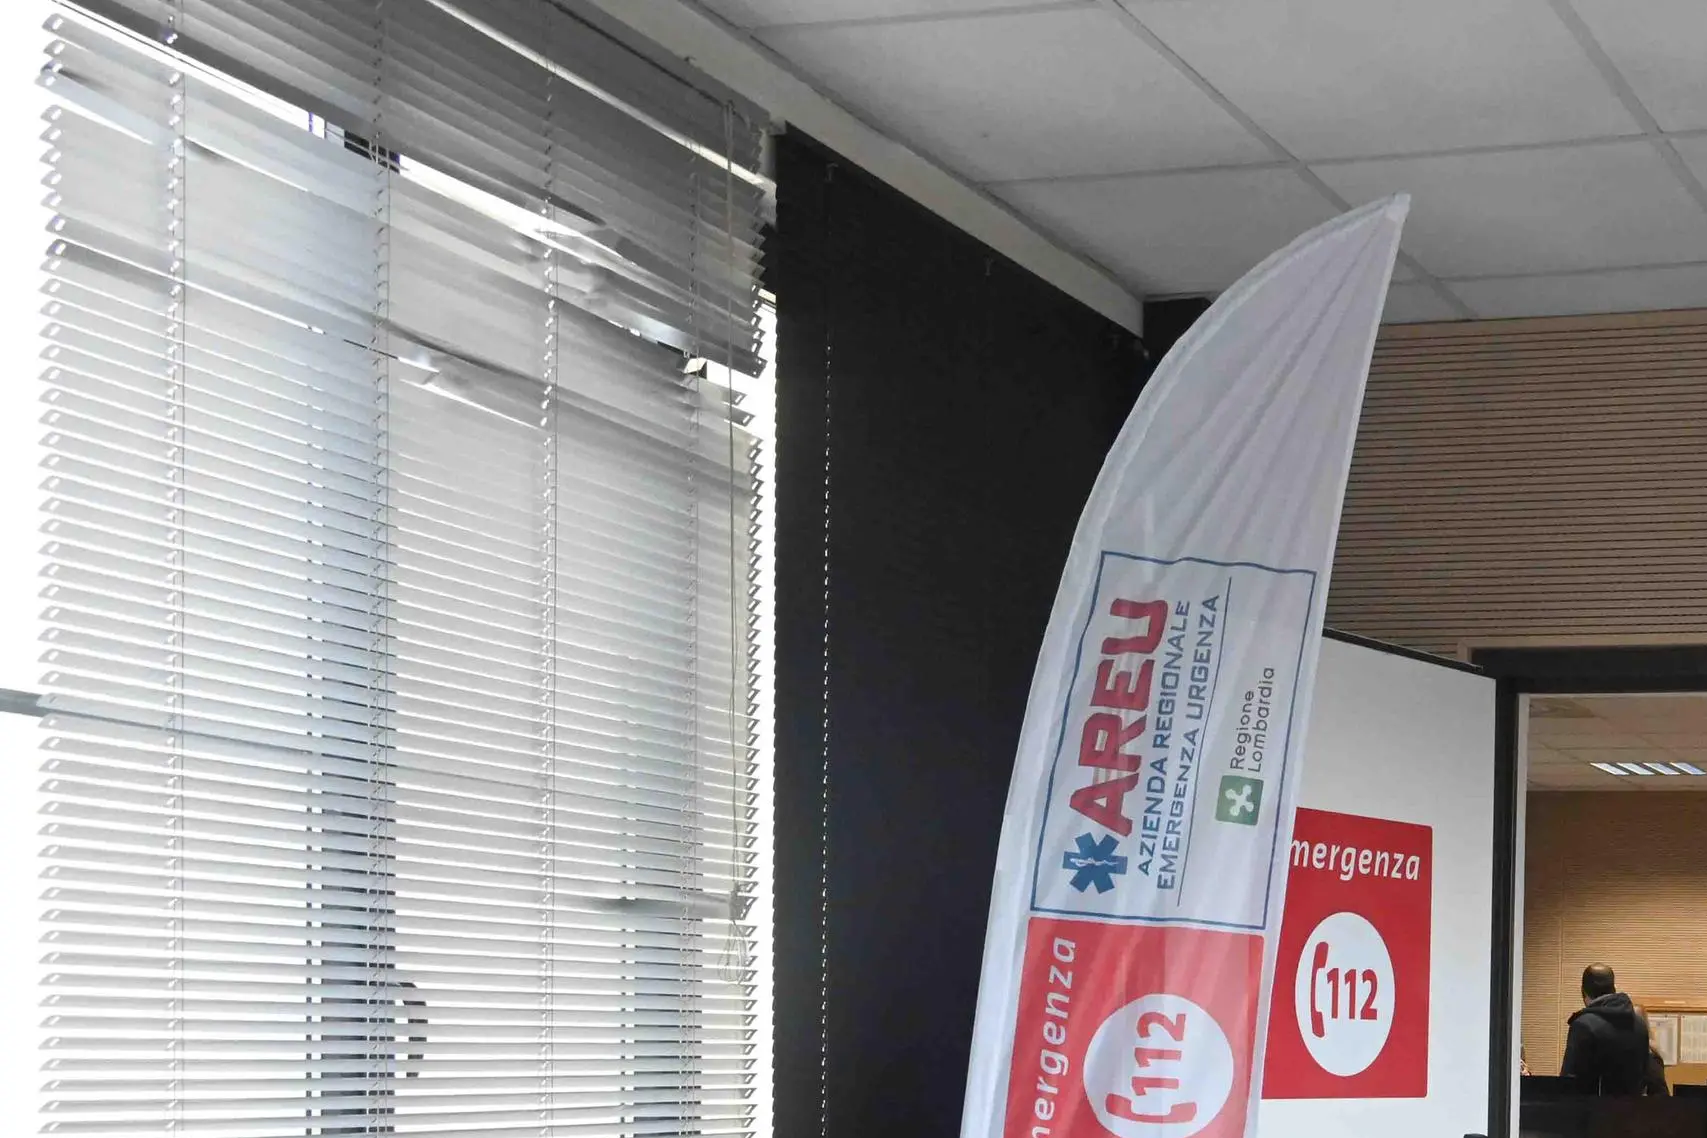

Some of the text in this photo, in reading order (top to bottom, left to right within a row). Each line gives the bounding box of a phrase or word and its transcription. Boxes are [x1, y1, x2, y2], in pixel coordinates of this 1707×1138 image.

[1068, 597, 1169, 838] AREU
[1138, 600, 1190, 877] AZIENDA REGIONALE
[1157, 595, 1220, 890] EMERGENZA URGENZA
[1230, 689, 1255, 771] Regione
[1248, 666, 1275, 773] Lombardia
[1291, 839, 1420, 881] mergenza
[1326, 967, 1378, 1020] 112
[1131, 1011, 1187, 1096] 112
